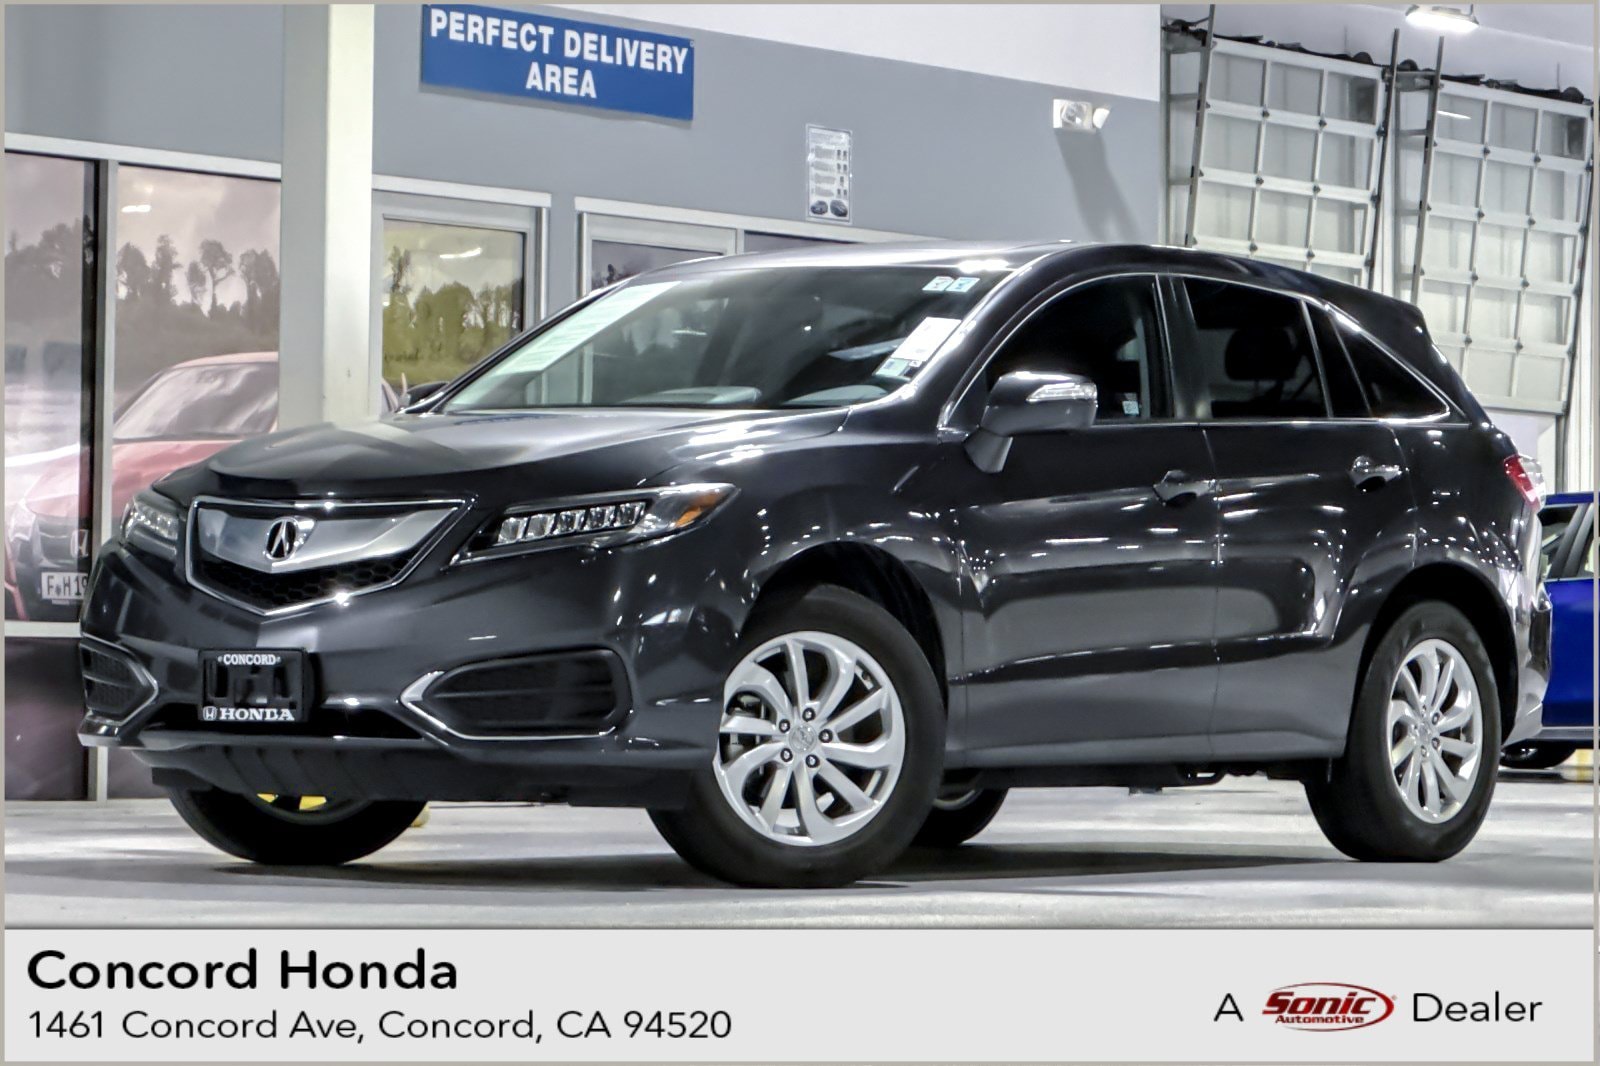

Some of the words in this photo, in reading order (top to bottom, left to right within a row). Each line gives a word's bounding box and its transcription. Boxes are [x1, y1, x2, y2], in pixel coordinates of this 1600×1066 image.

[430, 8, 554, 54] PERFECT
[564, 29, 688, 74] DELIVERY
[525, 62, 597, 98] AREA
[223, 653, 276, 665] CONCORD
[219, 708, 295, 721] HONDA
